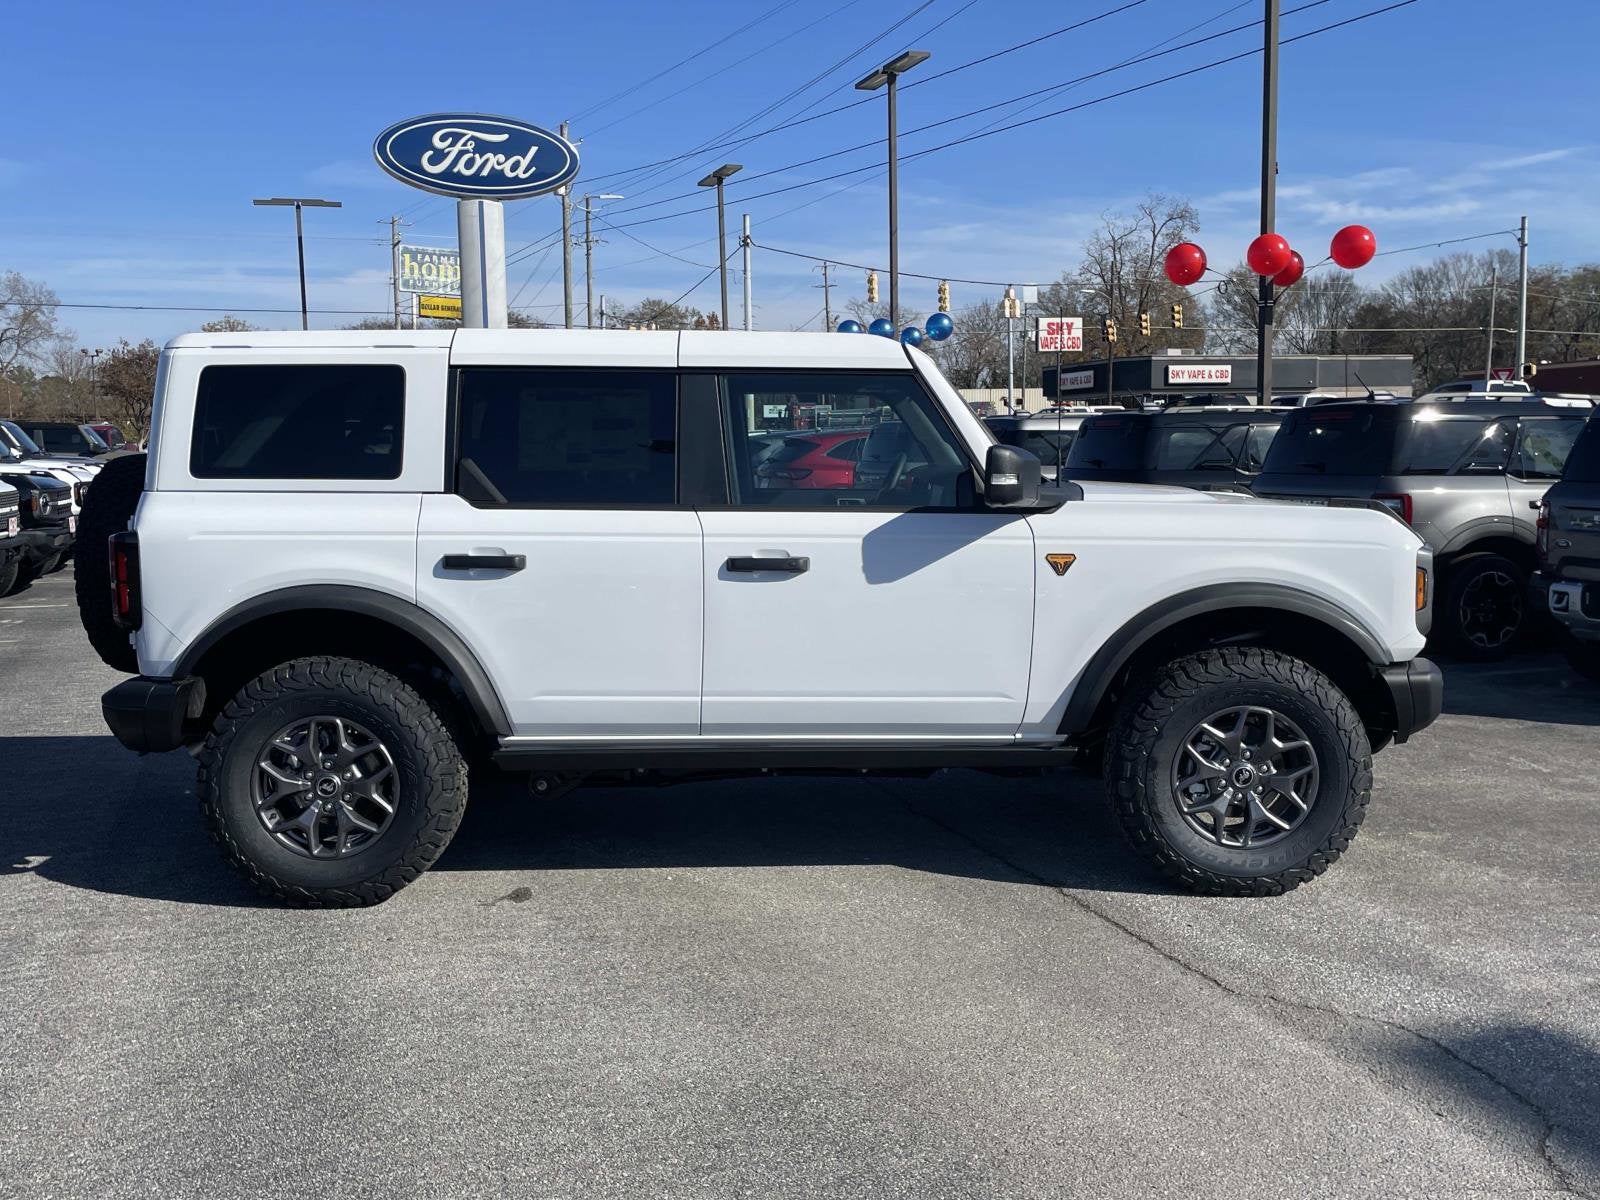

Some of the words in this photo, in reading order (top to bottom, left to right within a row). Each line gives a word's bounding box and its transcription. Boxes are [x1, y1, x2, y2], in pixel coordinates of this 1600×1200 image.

[421, 128, 538, 179] Ford
[421, 303, 440, 311] DOLLAR
[1047, 322, 1073, 335] SKY
[1040, 336, 1059, 349] VAPE
[1060, 336, 1066, 349] &
[1066, 336, 1081, 349] CBD
[1171, 369, 1185, 379] SKY
[1187, 369, 1206, 379] VAPE
[1208, 369, 1213, 379] &
[1215, 369, 1229, 379] CBD
